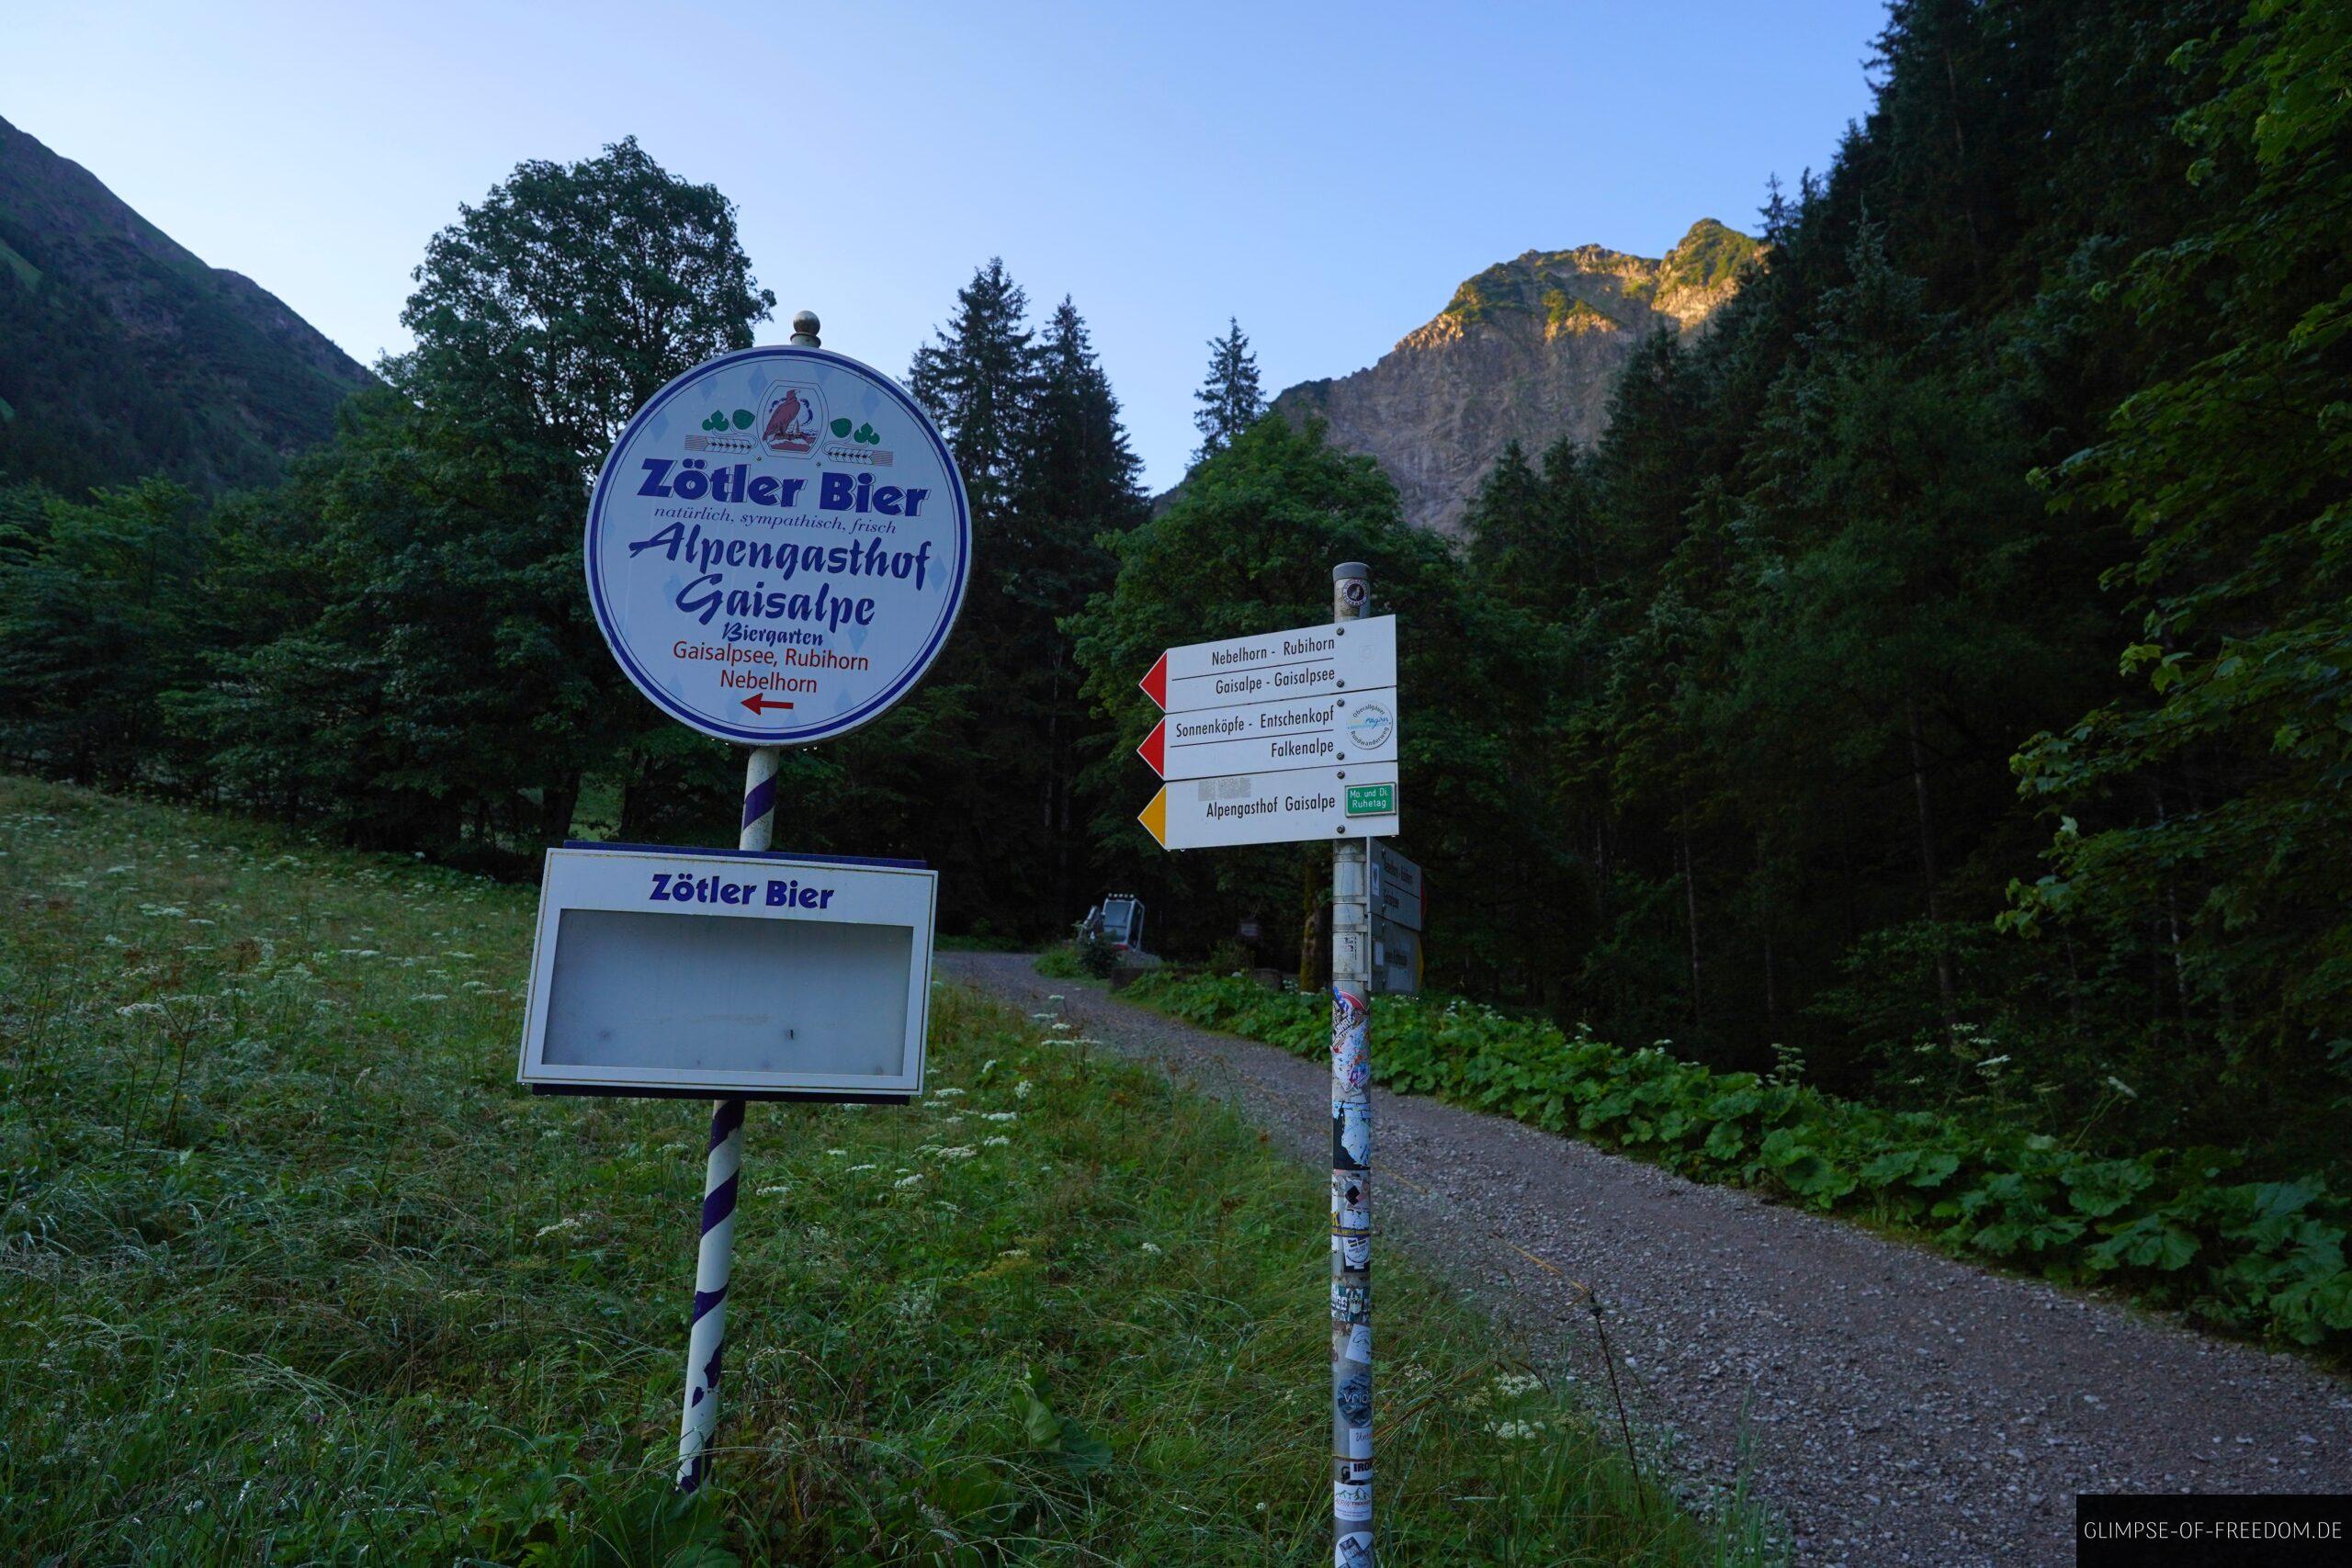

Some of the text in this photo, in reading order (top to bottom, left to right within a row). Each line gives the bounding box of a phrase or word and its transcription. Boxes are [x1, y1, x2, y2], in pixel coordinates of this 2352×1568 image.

[637, 457, 933, 517] Zötler Bier
[653, 505, 897, 535] natürlich, sympathisch, frisch
[629, 522, 932, 591] Alpengasthof
[676, 574, 876, 633] Gaisalpe
[722, 621, 824, 648] Biergarten
[673, 640, 869, 671] Gaisalpsee, Rubihorn
[1212, 646, 1268, 666] Nebelhorn
[1283, 636, 1335, 657] Rubihorn
[720, 670, 818, 694] Nebelhorn
[1216, 675, 1262, 695] Gaisalpe
[1274, 669, 1335, 689] Gaisalpsee
[1176, 716, 1244, 739] Sonnenköpfe
[1260, 705, 1334, 729] Entschenkopf
[1271, 739, 1334, 759] Falkenalpe
[1351, 727, 1390, 746] Rundwanderweg
[1350, 787, 1389, 798] Mo. und Di.
[1352, 797, 1386, 808] Ruhetag
[1205, 794, 1335, 821] Alpengasthof Gaisalpe
[649, 873, 834, 909] Zötler Bier
